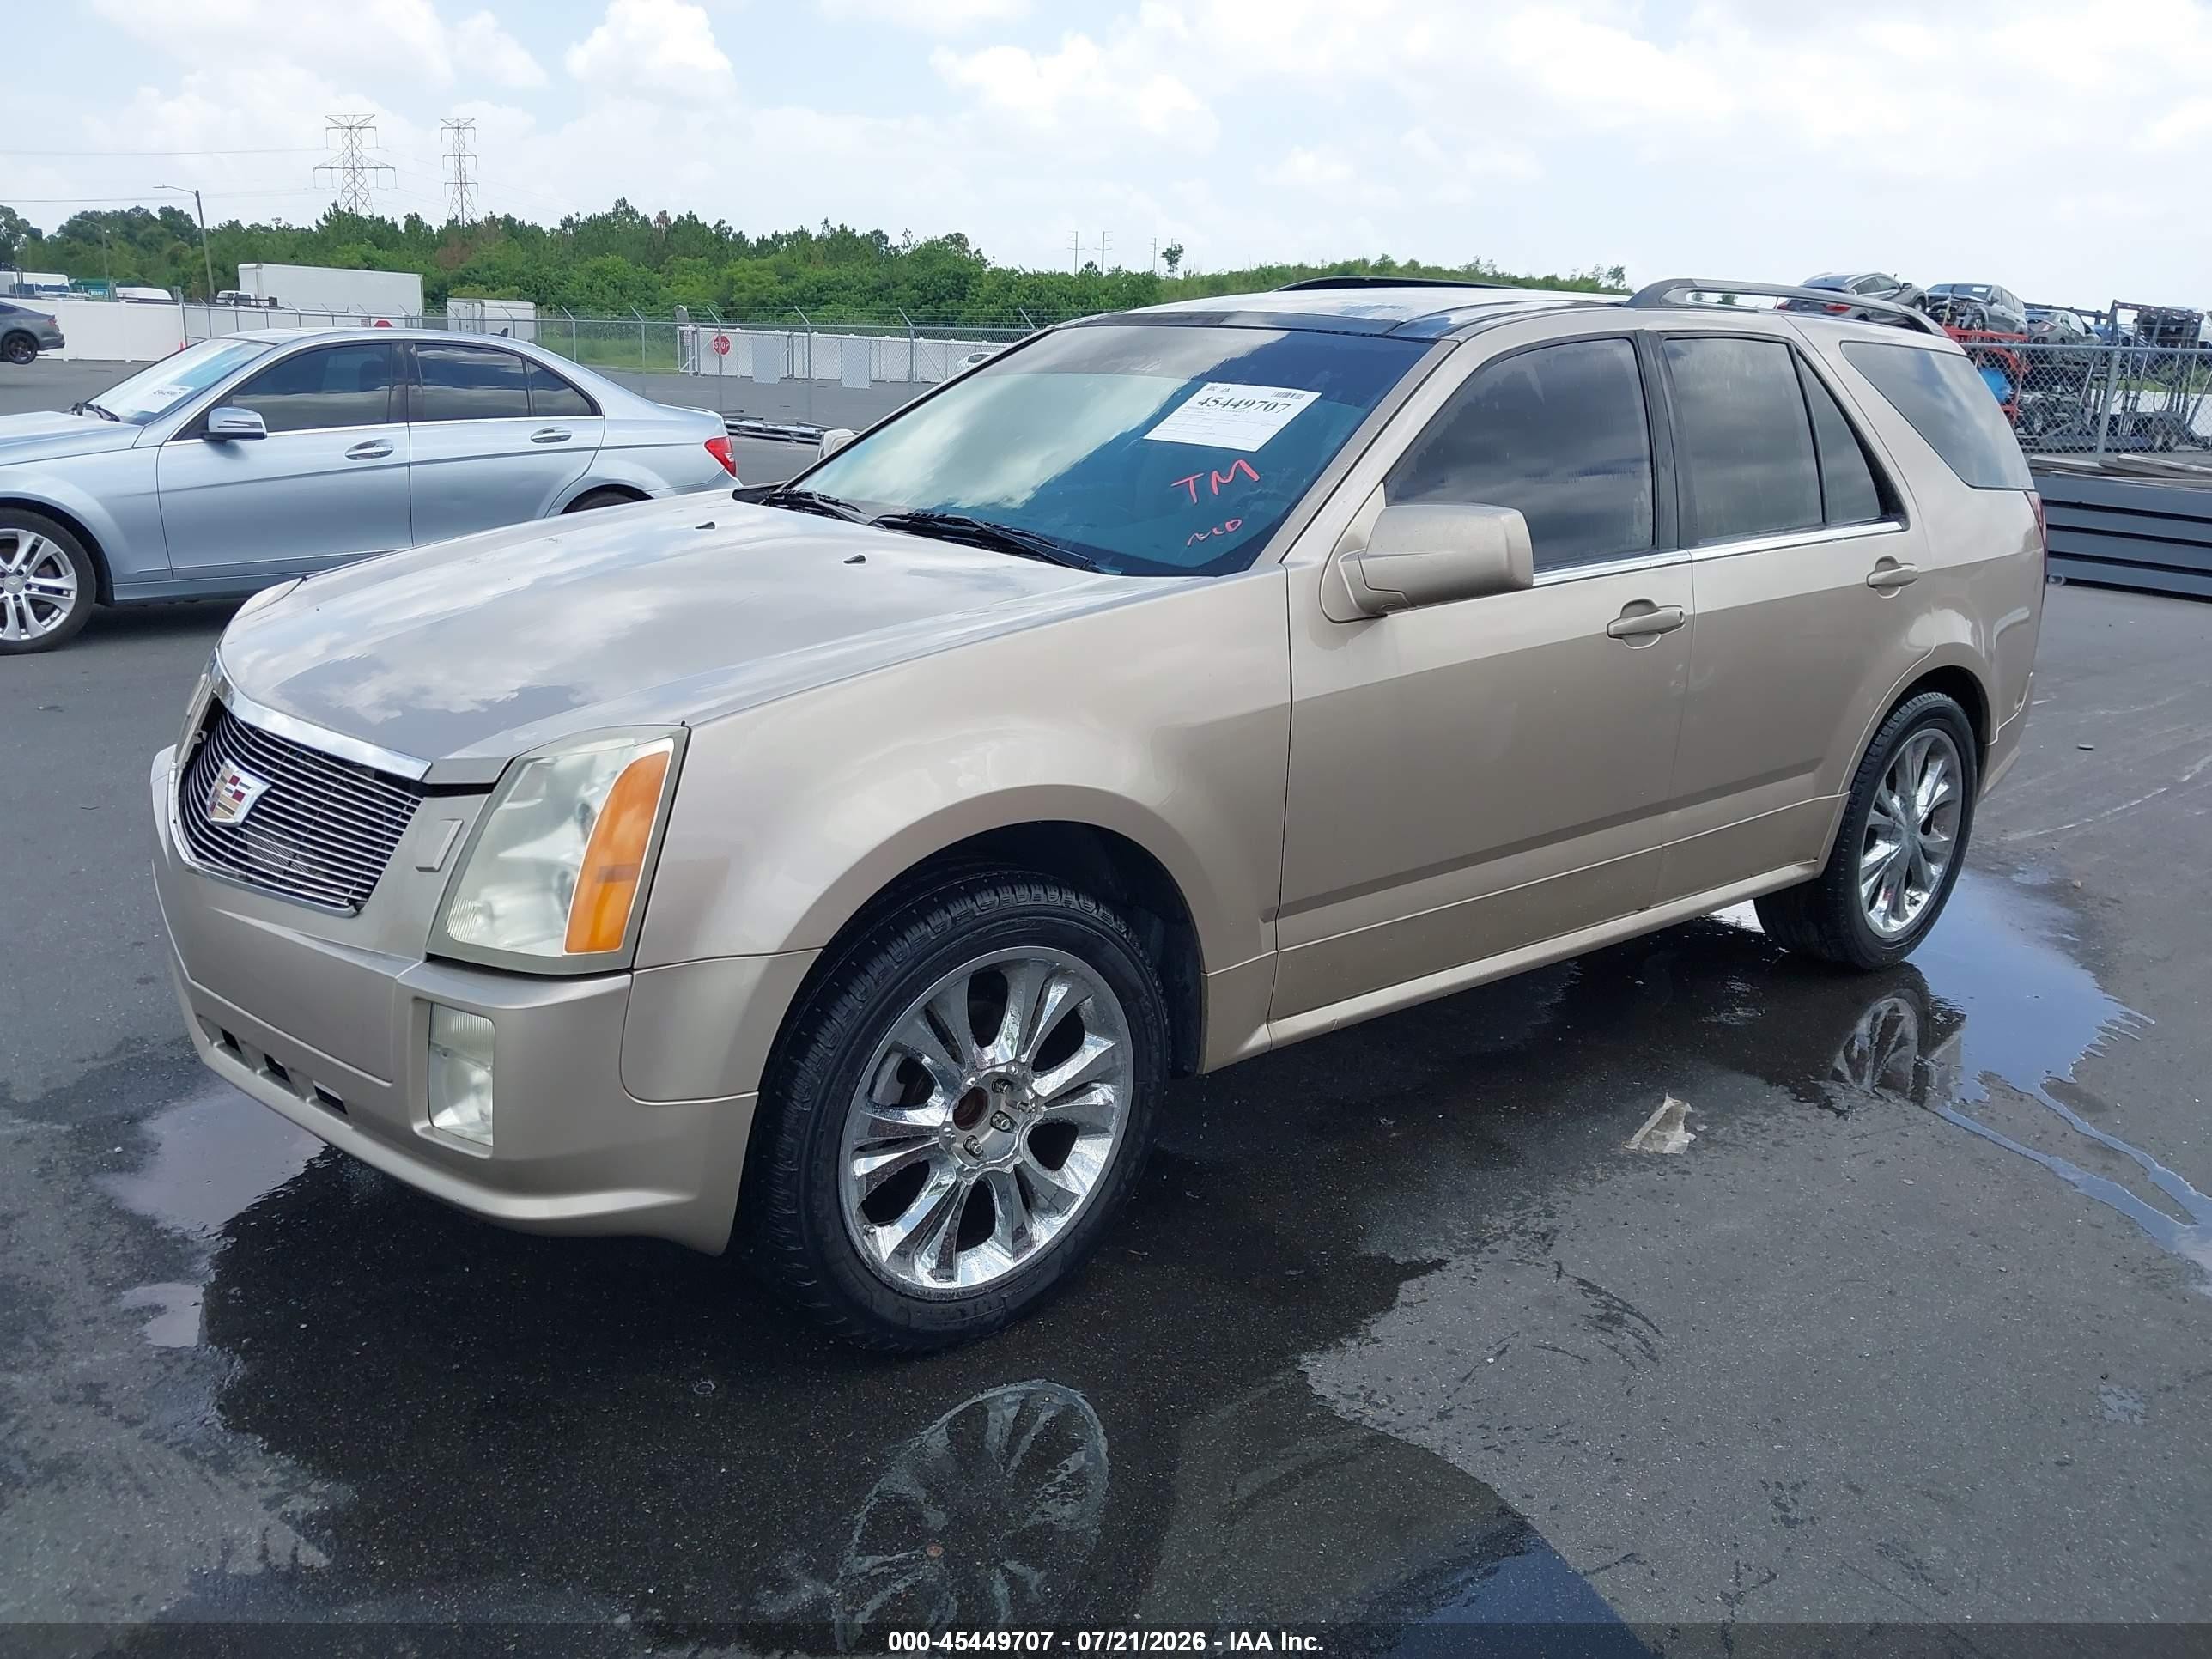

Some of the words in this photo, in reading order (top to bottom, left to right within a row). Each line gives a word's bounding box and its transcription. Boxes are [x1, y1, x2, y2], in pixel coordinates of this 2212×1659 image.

[714, 341, 729, 349] SOP
[1198, 396, 1292, 414] 45449707
[1170, 459, 1260, 504] TM
